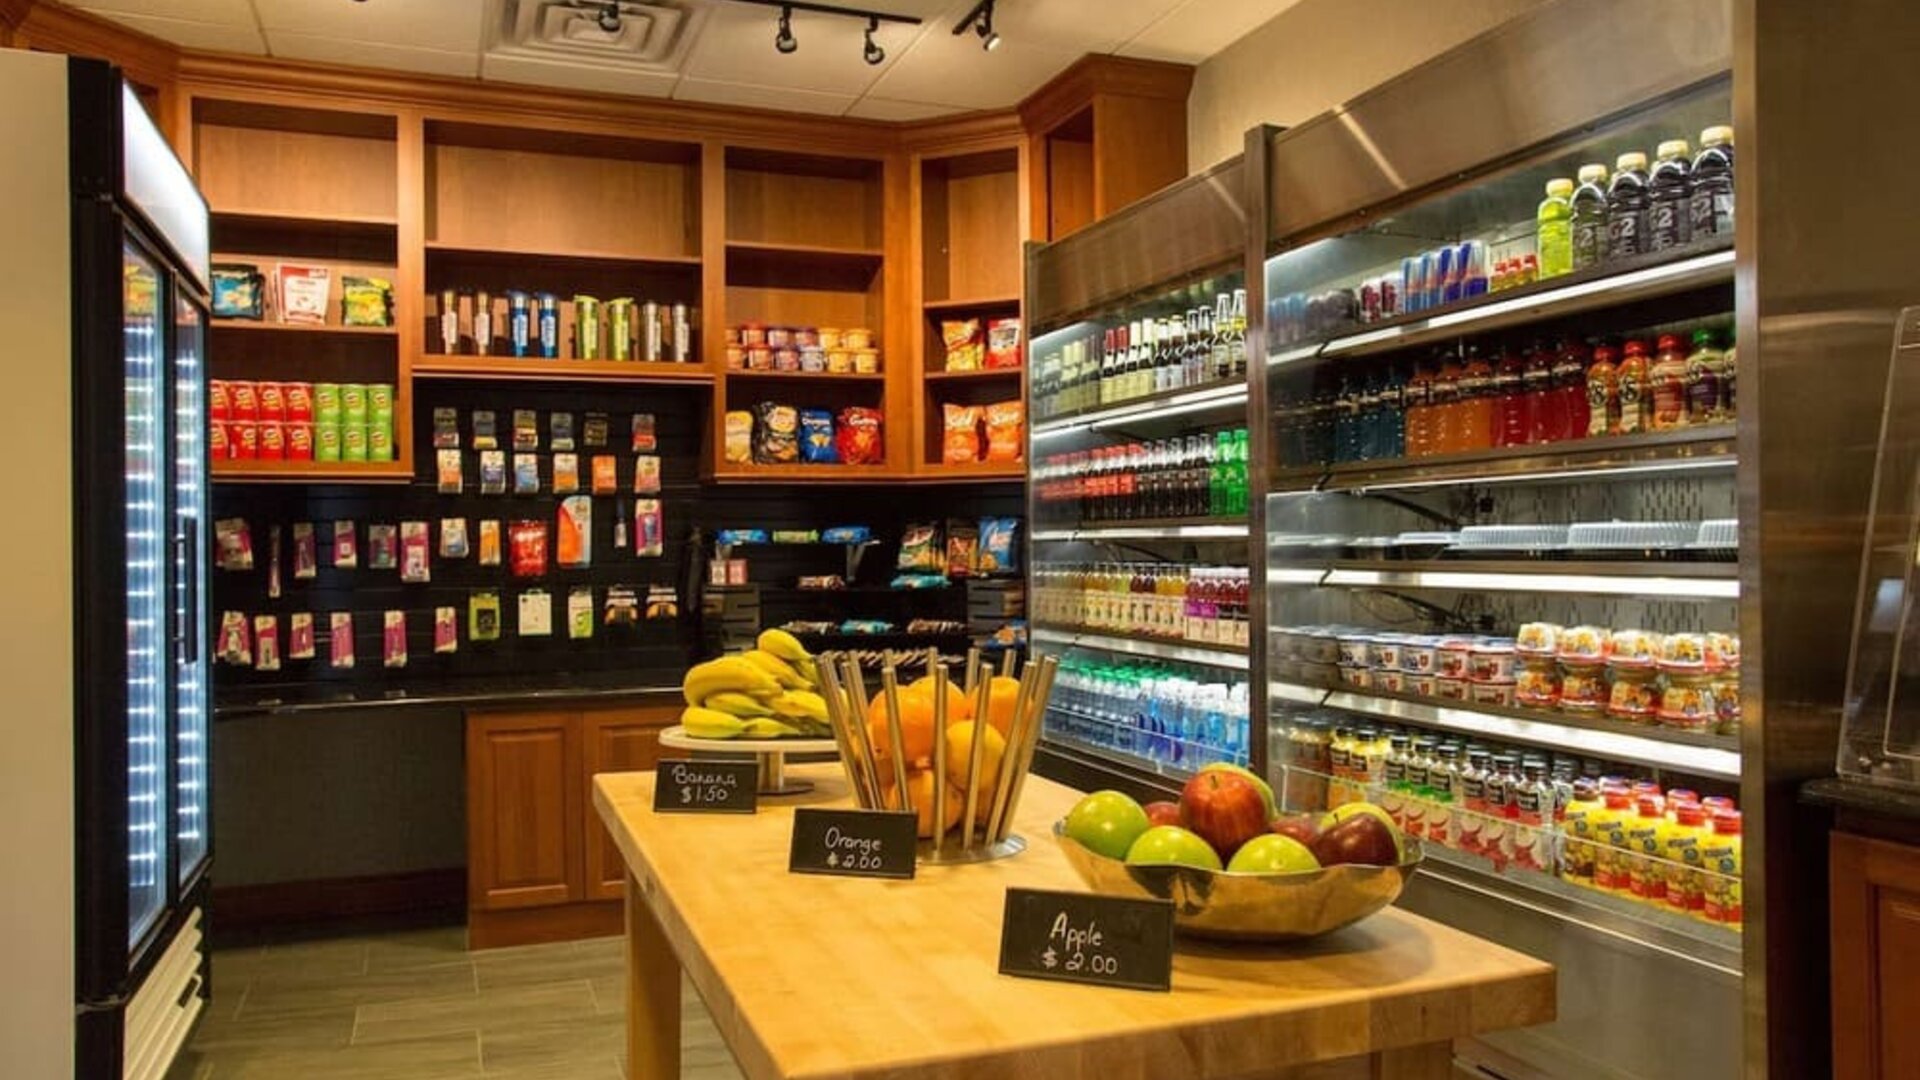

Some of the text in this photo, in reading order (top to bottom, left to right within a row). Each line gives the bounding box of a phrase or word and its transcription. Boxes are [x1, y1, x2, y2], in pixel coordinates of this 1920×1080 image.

[671, 764, 738, 788] Banana
[825, 827, 882, 855] Orange
[1050, 911, 1103, 951] Apple
